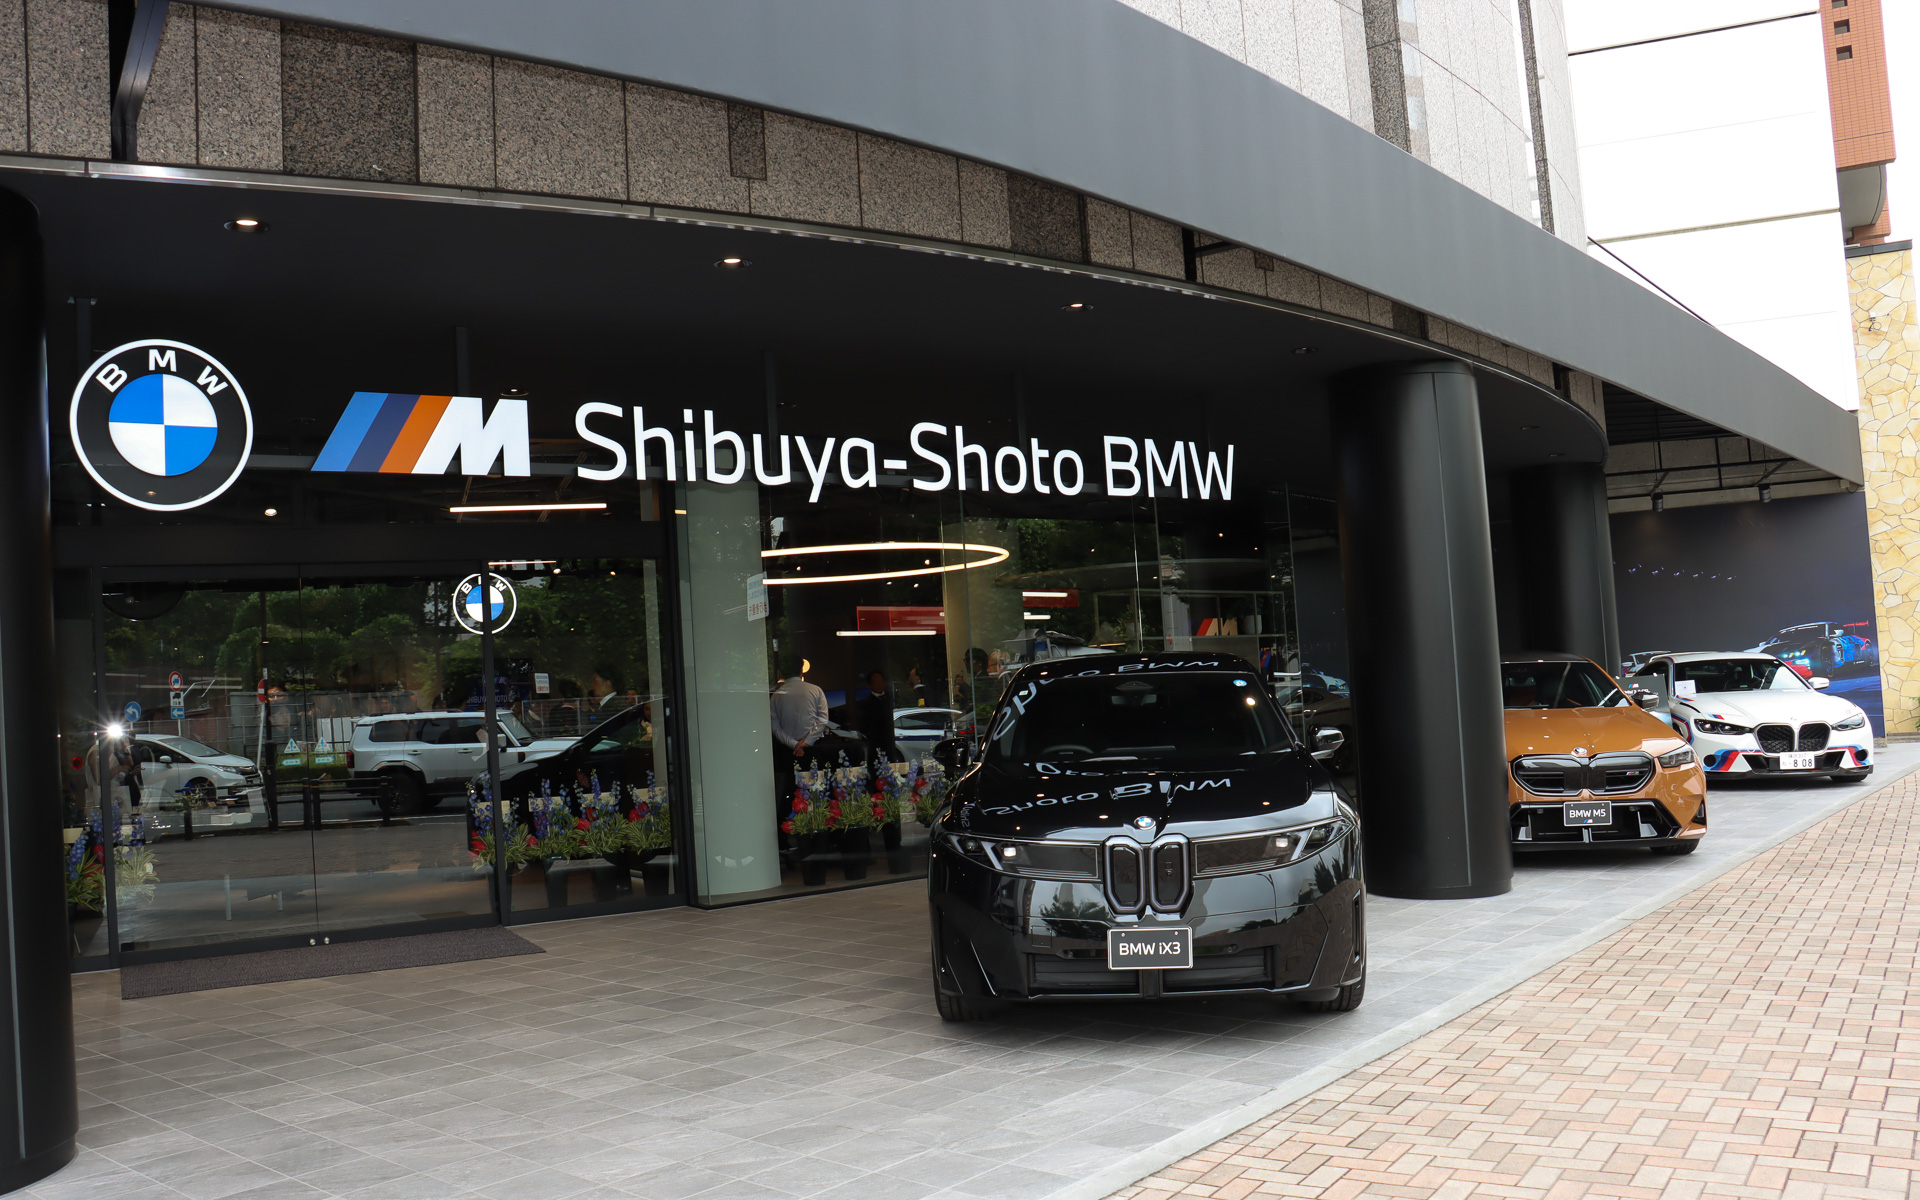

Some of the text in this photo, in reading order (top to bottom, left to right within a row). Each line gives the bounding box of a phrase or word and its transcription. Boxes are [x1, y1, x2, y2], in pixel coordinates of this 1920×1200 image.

[96, 349, 228, 396] BMW
[411, 396, 530, 477] M
[574, 402, 1234, 503] Shibuya-Shoto BMW
[461, 575, 507, 594] BW
[1569, 808, 1606, 818] BMW M5
[1119, 941, 1181, 955] BMW iX3
